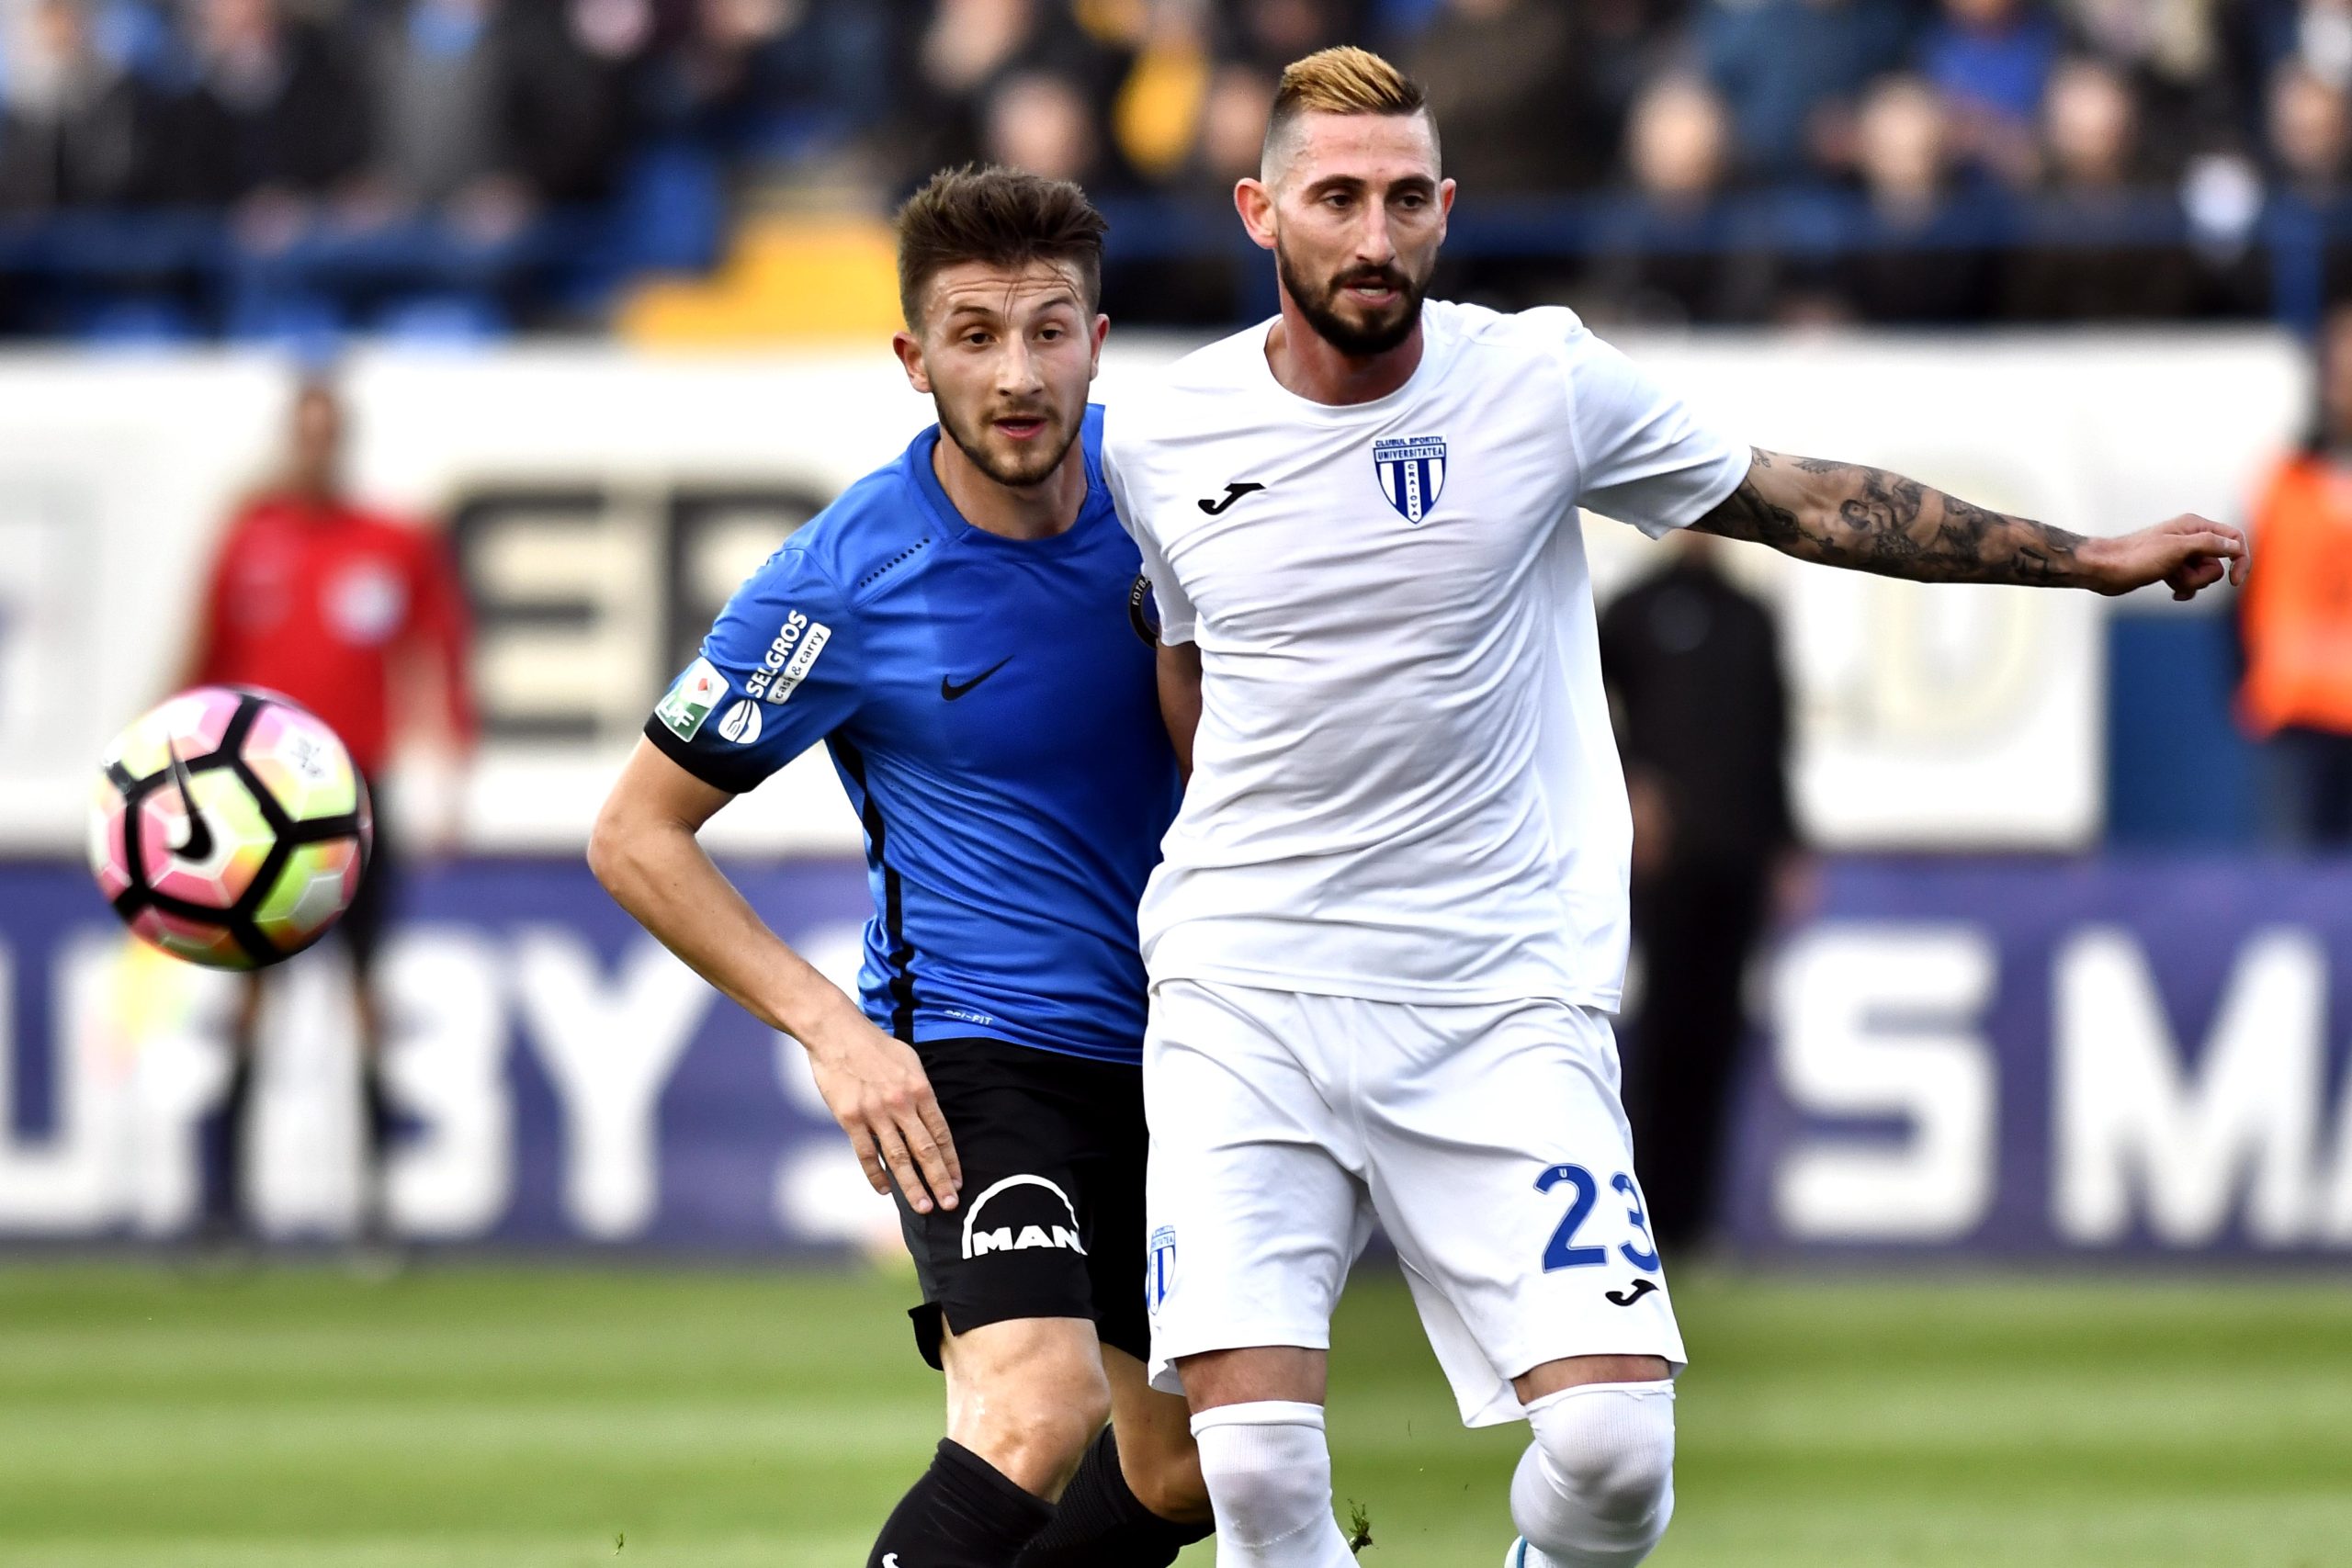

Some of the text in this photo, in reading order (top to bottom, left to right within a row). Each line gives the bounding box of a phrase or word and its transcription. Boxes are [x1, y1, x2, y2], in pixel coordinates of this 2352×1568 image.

[1375, 435, 1443, 447] CLUBUL SPORTIV
[1377, 446, 1443, 460] UNIVERSITATEA
[1407, 463, 1419, 516] CRAIOVA
[745, 609, 808, 699] SELGROS
[791, 666, 802, 676] &
[798, 631, 824, 665] carry
[972, 1224, 1082, 1256] MAN
[1533, 1163, 1660, 1274] 23
